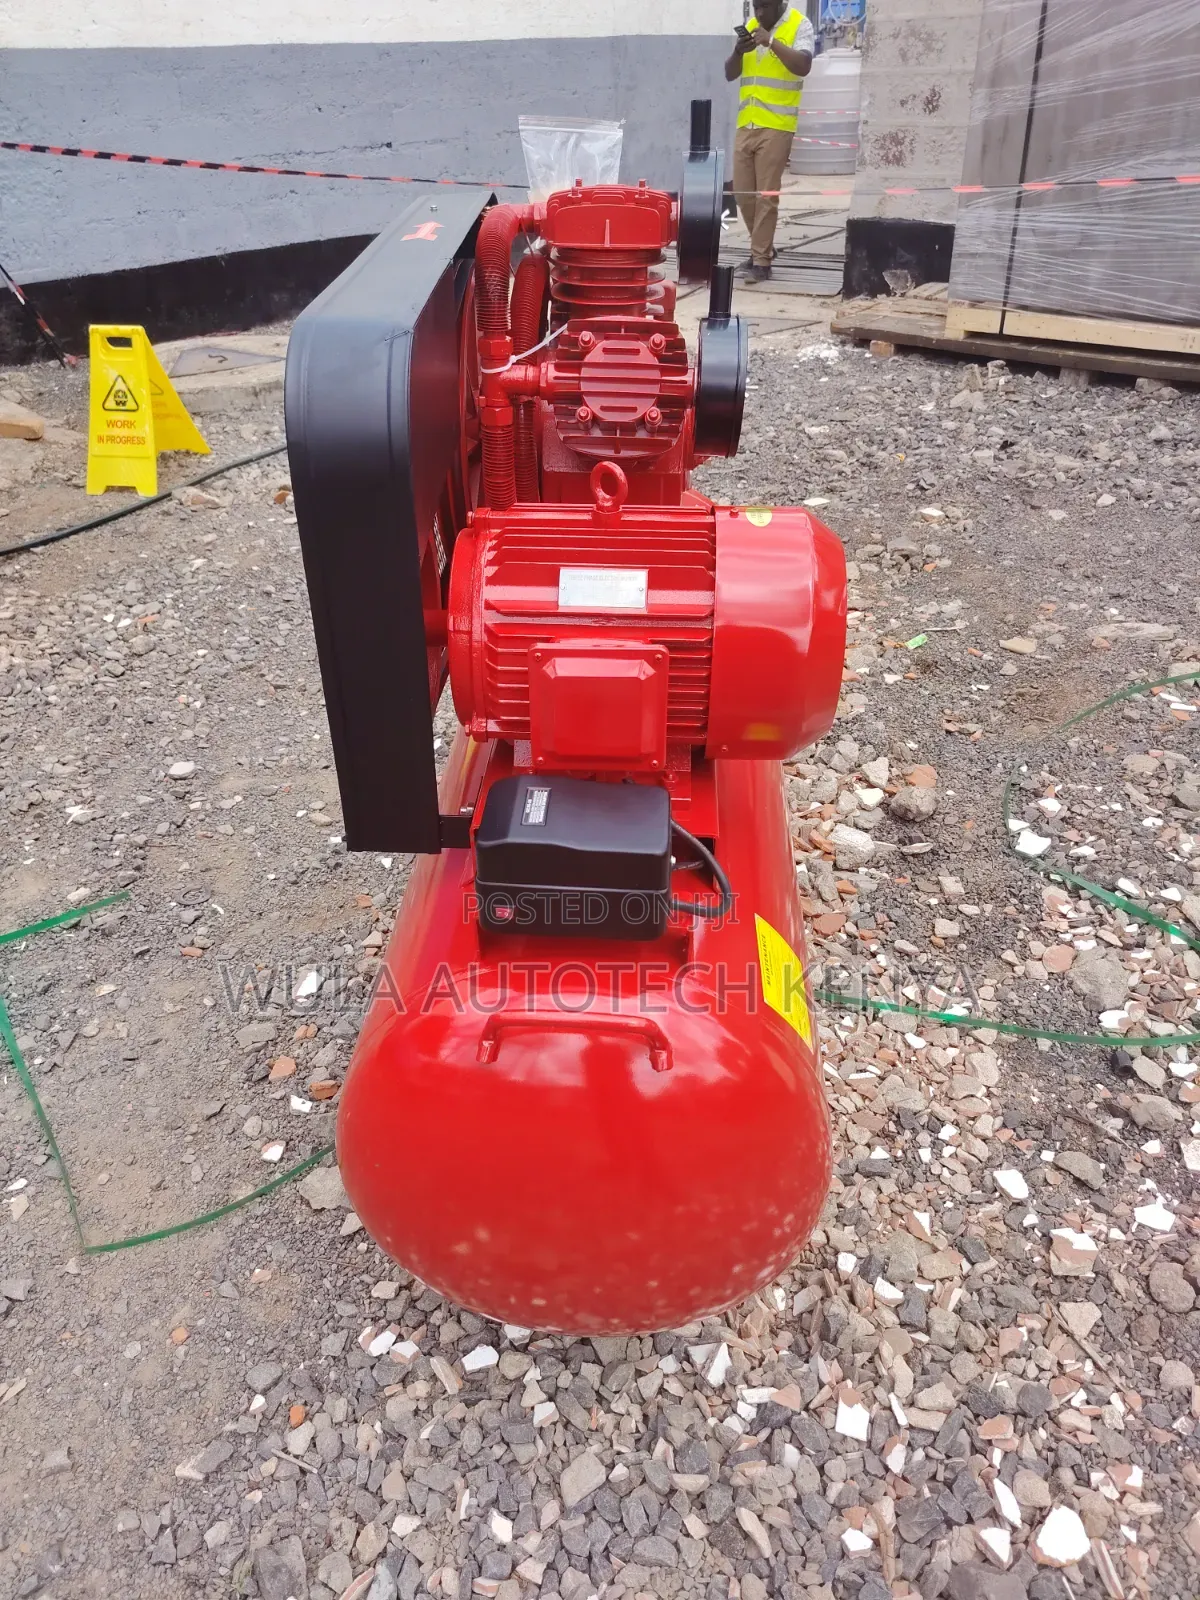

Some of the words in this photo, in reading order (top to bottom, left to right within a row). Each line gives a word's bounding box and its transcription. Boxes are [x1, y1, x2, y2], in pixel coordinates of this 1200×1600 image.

[106, 420, 136, 429] WORK
[97, 435, 105, 444] IN
[106, 435, 146, 445] PROGRESS
[761, 934, 772, 986] MAINTENANCE
